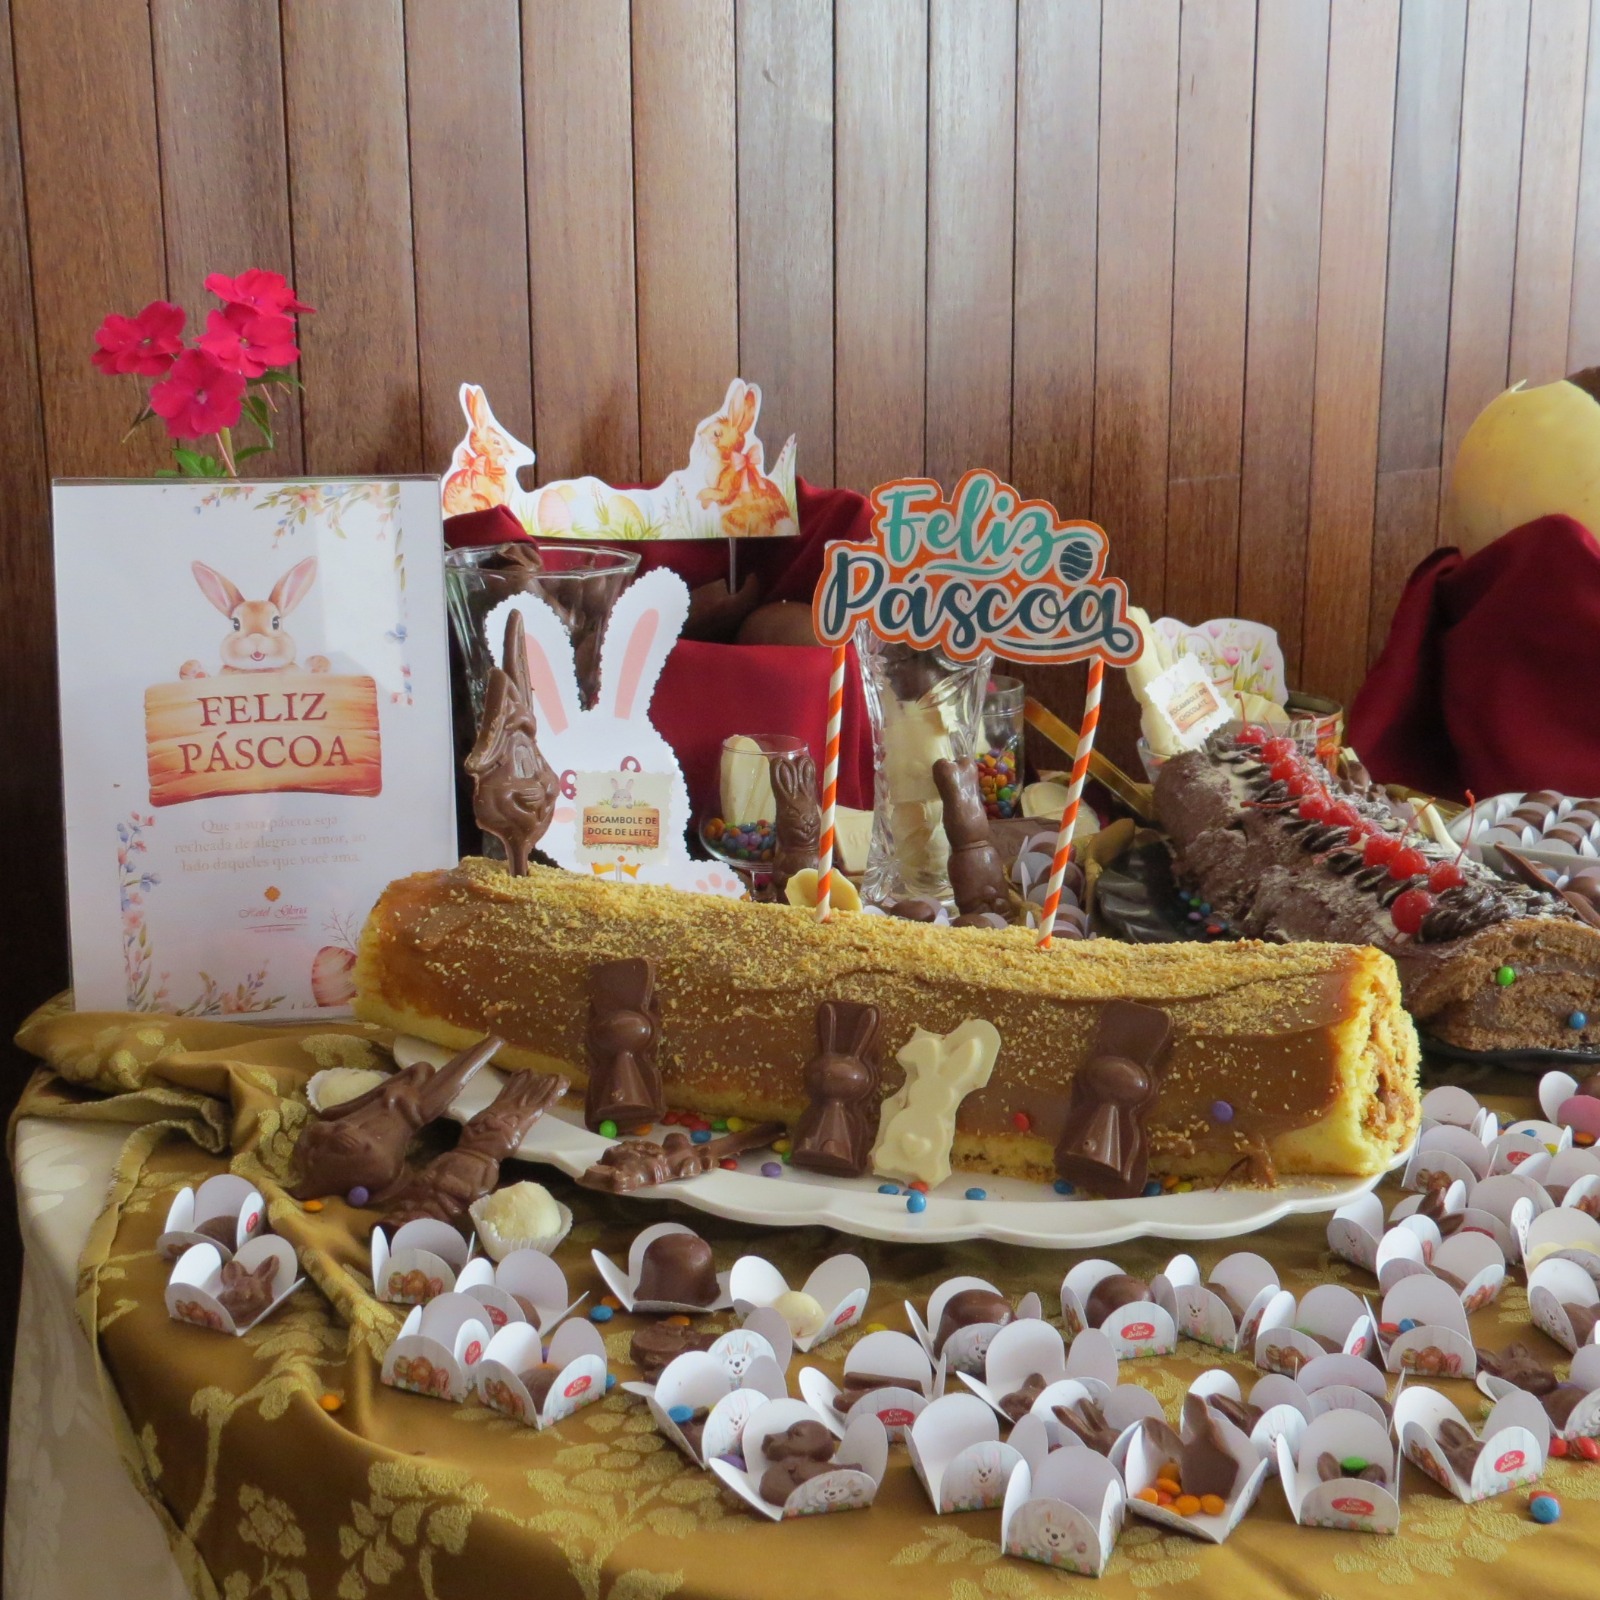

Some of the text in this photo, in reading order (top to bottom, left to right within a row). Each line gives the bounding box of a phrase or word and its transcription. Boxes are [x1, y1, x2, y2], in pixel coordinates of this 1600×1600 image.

[880, 478, 1102, 577] Feliz
[823, 551, 1135, 653] Páscoa
[198, 691, 328, 728] FELIZ
[177, 731, 354, 774] PÁSCOA
[201, 818, 230, 834] Que
[269, 815, 312, 832] páscoa
[313, 814, 339, 830] seja
[586, 815, 657, 825] ROCAMBOLE DE
[587, 827, 652, 837] DOCE DE LEITE
[174, 836, 233, 854] recheada
[254, 835, 297, 853] alegria
[181, 858, 210, 873] lado
[213, 855, 270, 874] daqueles
[272, 856, 296, 871] que
